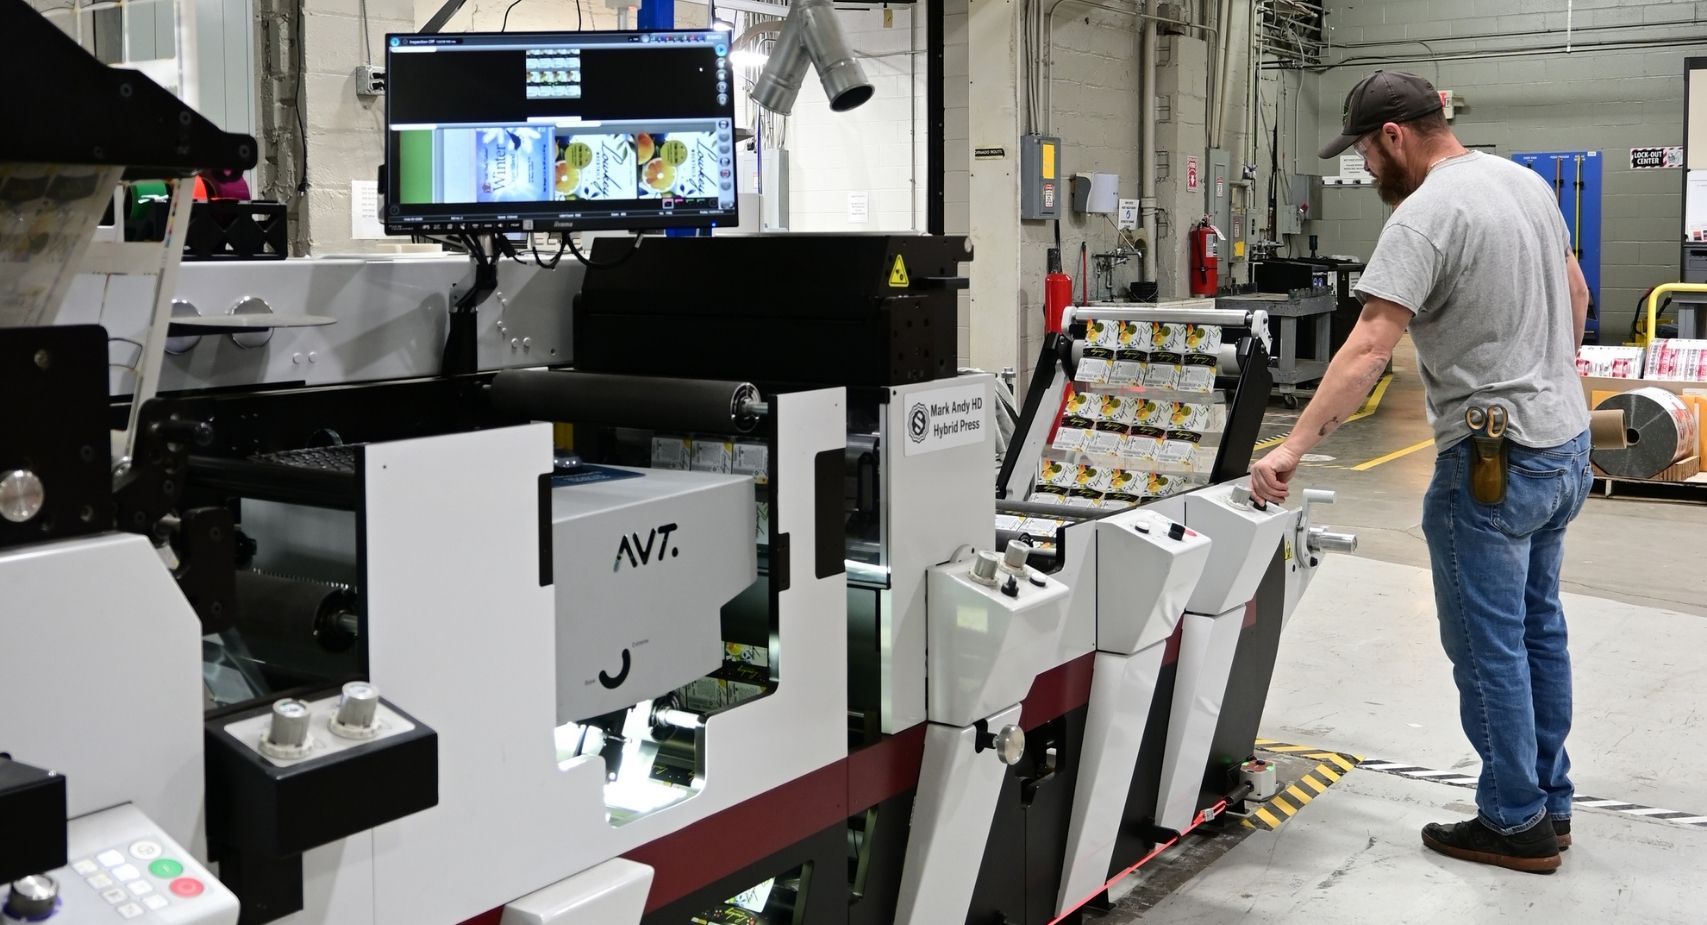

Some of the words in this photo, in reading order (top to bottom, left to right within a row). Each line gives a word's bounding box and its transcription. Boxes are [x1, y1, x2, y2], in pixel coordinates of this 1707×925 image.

[1634, 151, 1662, 159] LOCK-OUT
[493, 144, 506, 192] Winter
[930, 402, 950, 417] Mark
[952, 400, 970, 414] Andy
[971, 397, 983, 410] HD
[933, 420, 959, 439] Hybrid
[960, 419, 980, 432] Press
